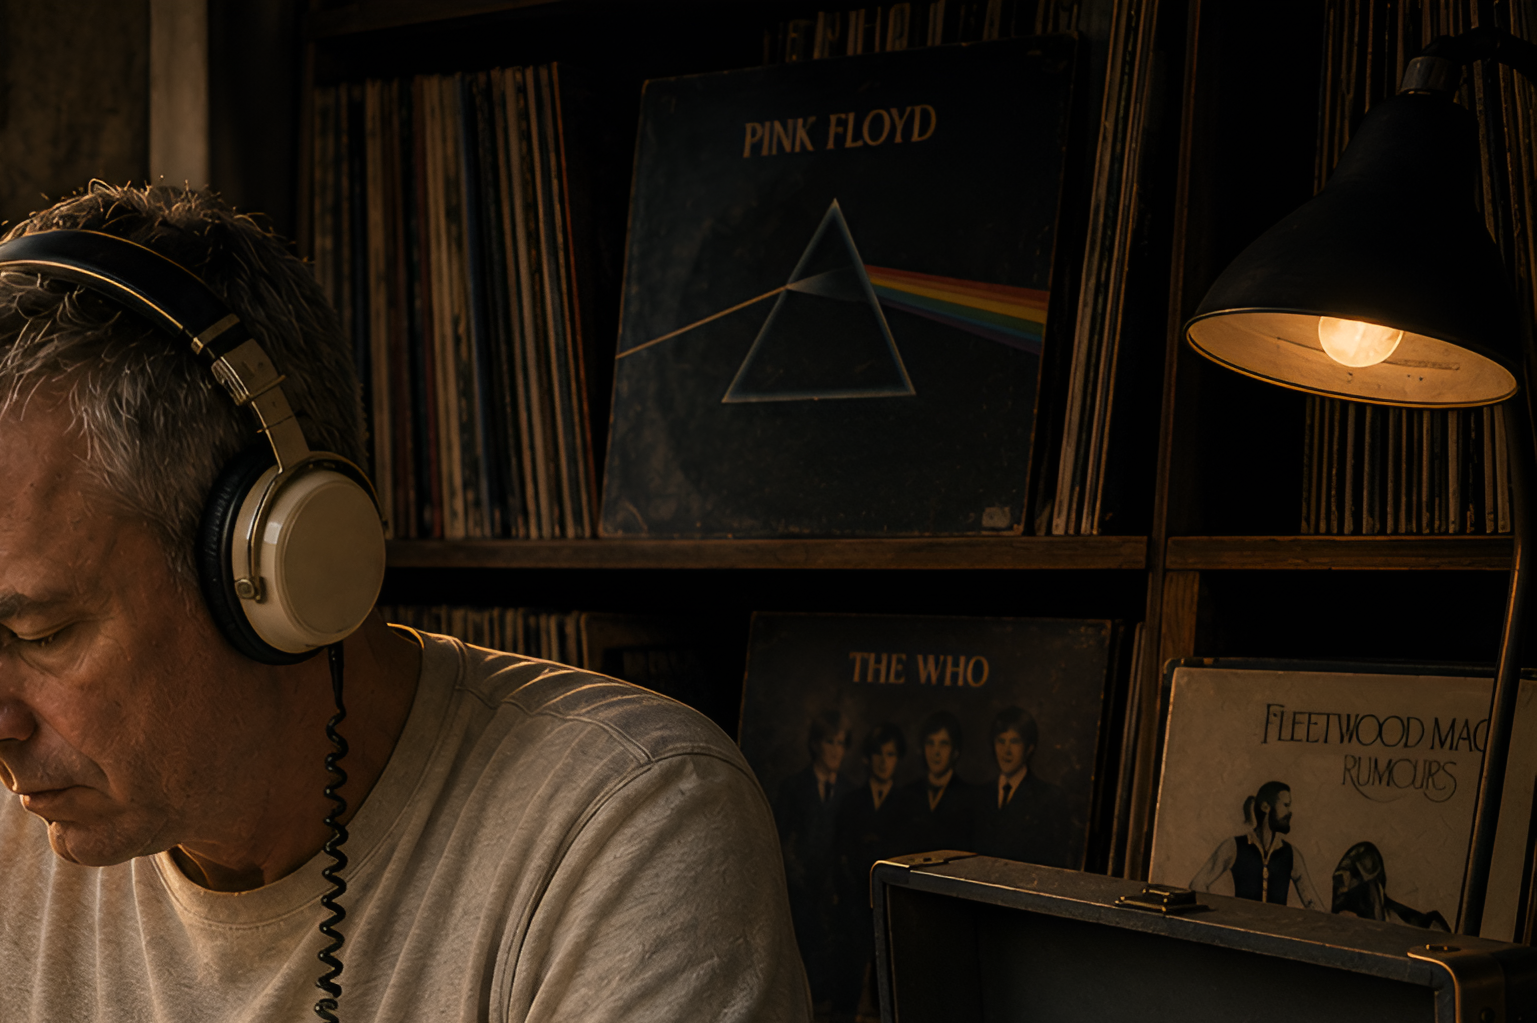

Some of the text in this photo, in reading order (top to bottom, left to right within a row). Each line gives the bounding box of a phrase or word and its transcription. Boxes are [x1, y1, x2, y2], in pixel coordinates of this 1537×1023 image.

[743, 104, 937, 158] PINK FLOYD
[849, 651, 990, 687] THE WHO
[1261, 702, 1489, 753] FLEETWOOD MAC
[1341, 753, 1458, 803] RUMOURS
